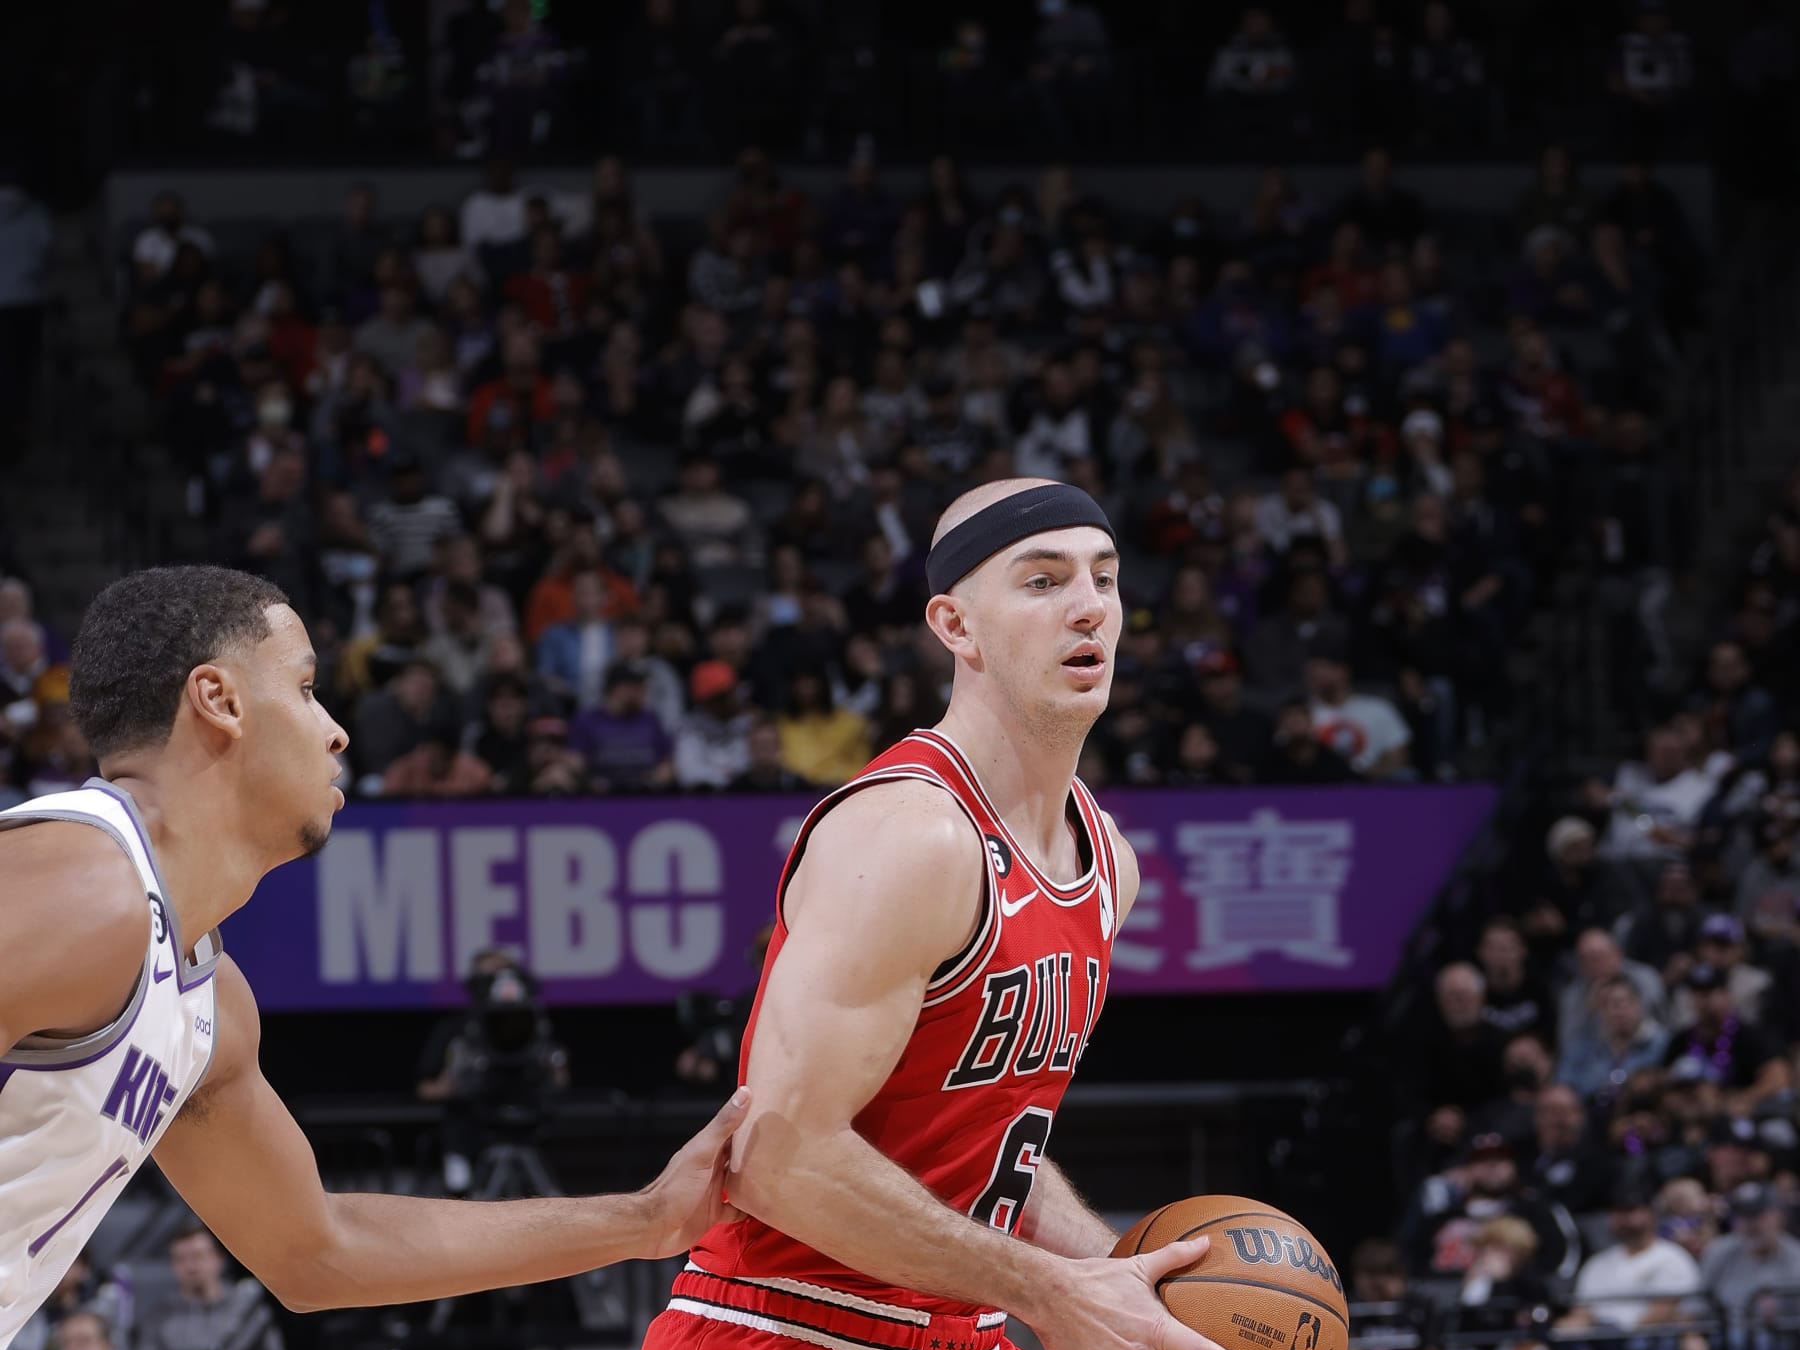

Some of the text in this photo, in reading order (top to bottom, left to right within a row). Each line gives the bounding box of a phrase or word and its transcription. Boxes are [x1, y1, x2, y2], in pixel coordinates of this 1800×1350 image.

[317, 819, 723, 984] MEBO
[967, 1105, 1054, 1236] 6
[1224, 1227, 1343, 1294] Wilso
[1231, 1312, 1287, 1343] OFFICIAL GAME BALL
